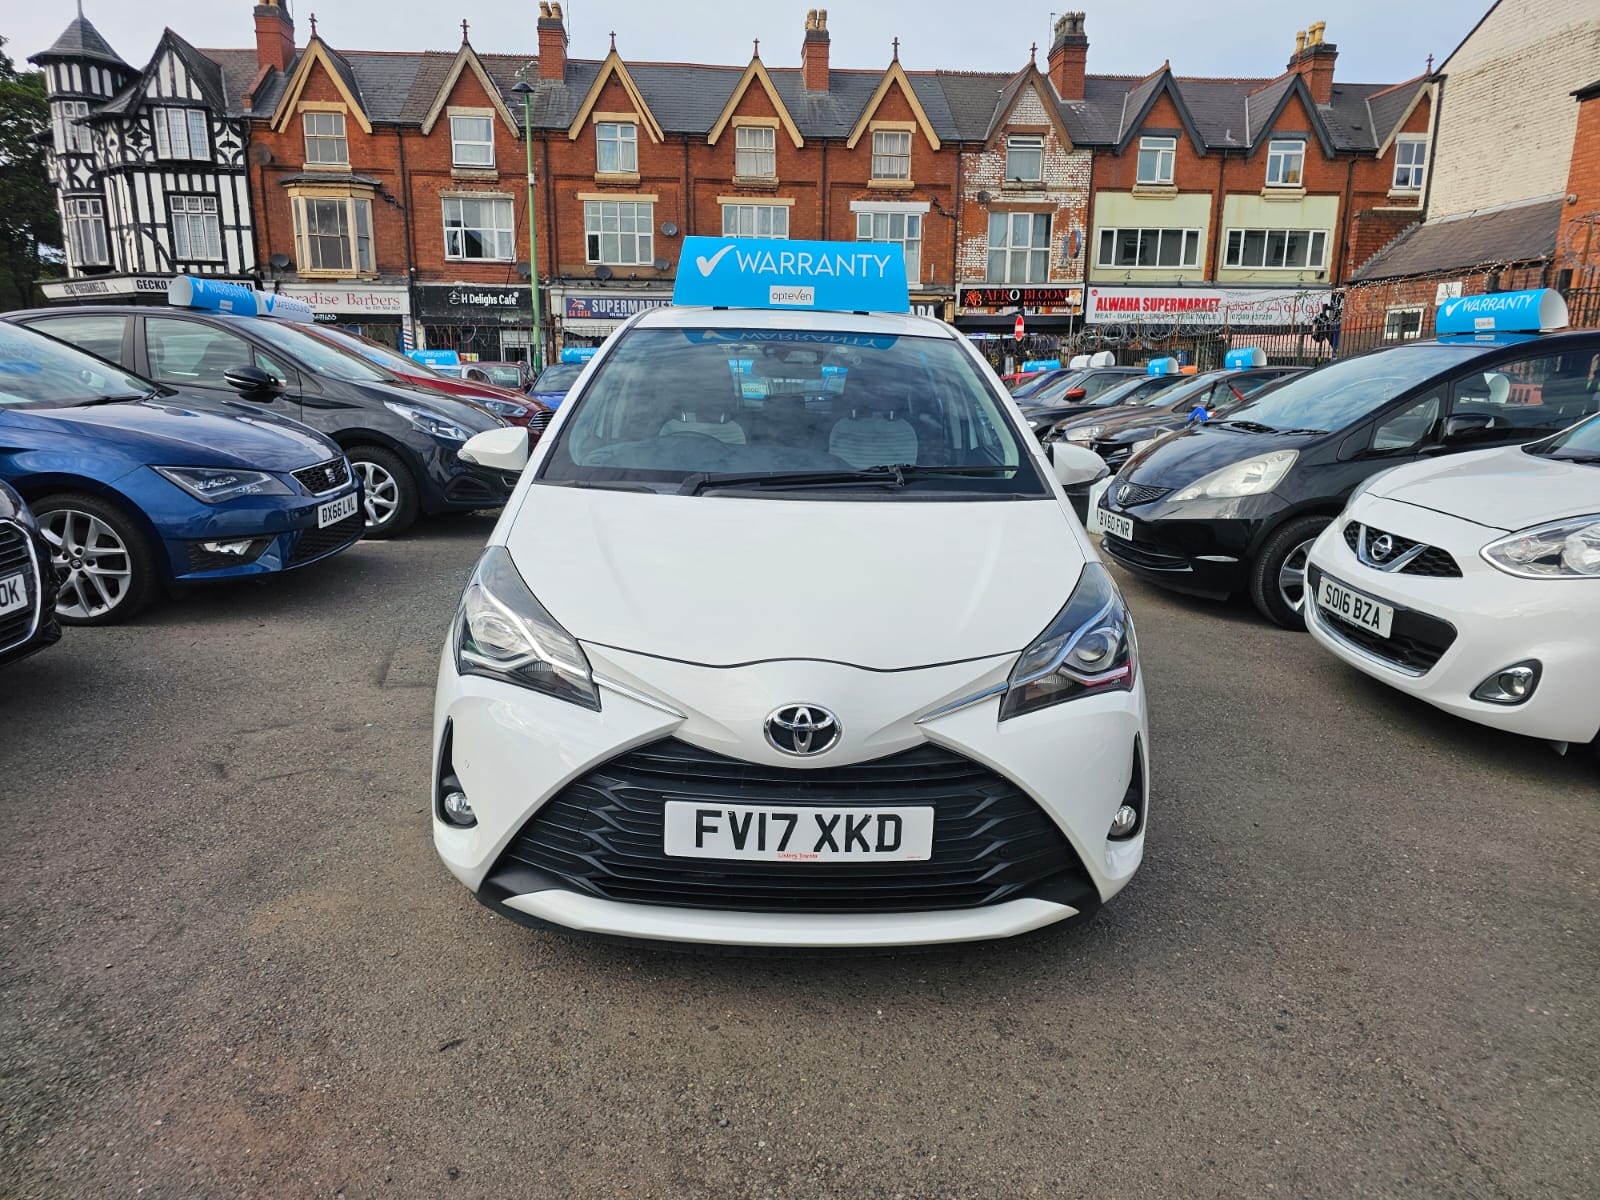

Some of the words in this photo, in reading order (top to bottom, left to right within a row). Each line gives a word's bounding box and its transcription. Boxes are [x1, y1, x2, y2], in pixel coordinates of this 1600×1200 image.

[736, 250, 891, 278] WARRANTY
[136, 279, 167, 291] GECKO
[206, 281, 250, 299] WARRANTY
[279, 291, 339, 305] adise
[347, 292, 401, 306] Barbers
[461, 294, 468, 304] H
[470, 294, 498, 306] Delighs
[499, 293, 517, 305] Cafe
[772, 289, 812, 302] opteven
[984, 289, 1020, 302] AFRO
[1023, 289, 1069, 300] BLOOM
[1462, 294, 1537, 313] WARRANTY
[1096, 297, 1139, 312] ALWAHA
[1143, 297, 1221, 313] SUPERMARKET
[322, 502, 342, 523] DX66
[1325, 584, 1351, 614] SO16
[1353, 597, 1380, 630] BZA
[695, 809, 798, 851] FV17
[813, 813, 903, 853] XKD
